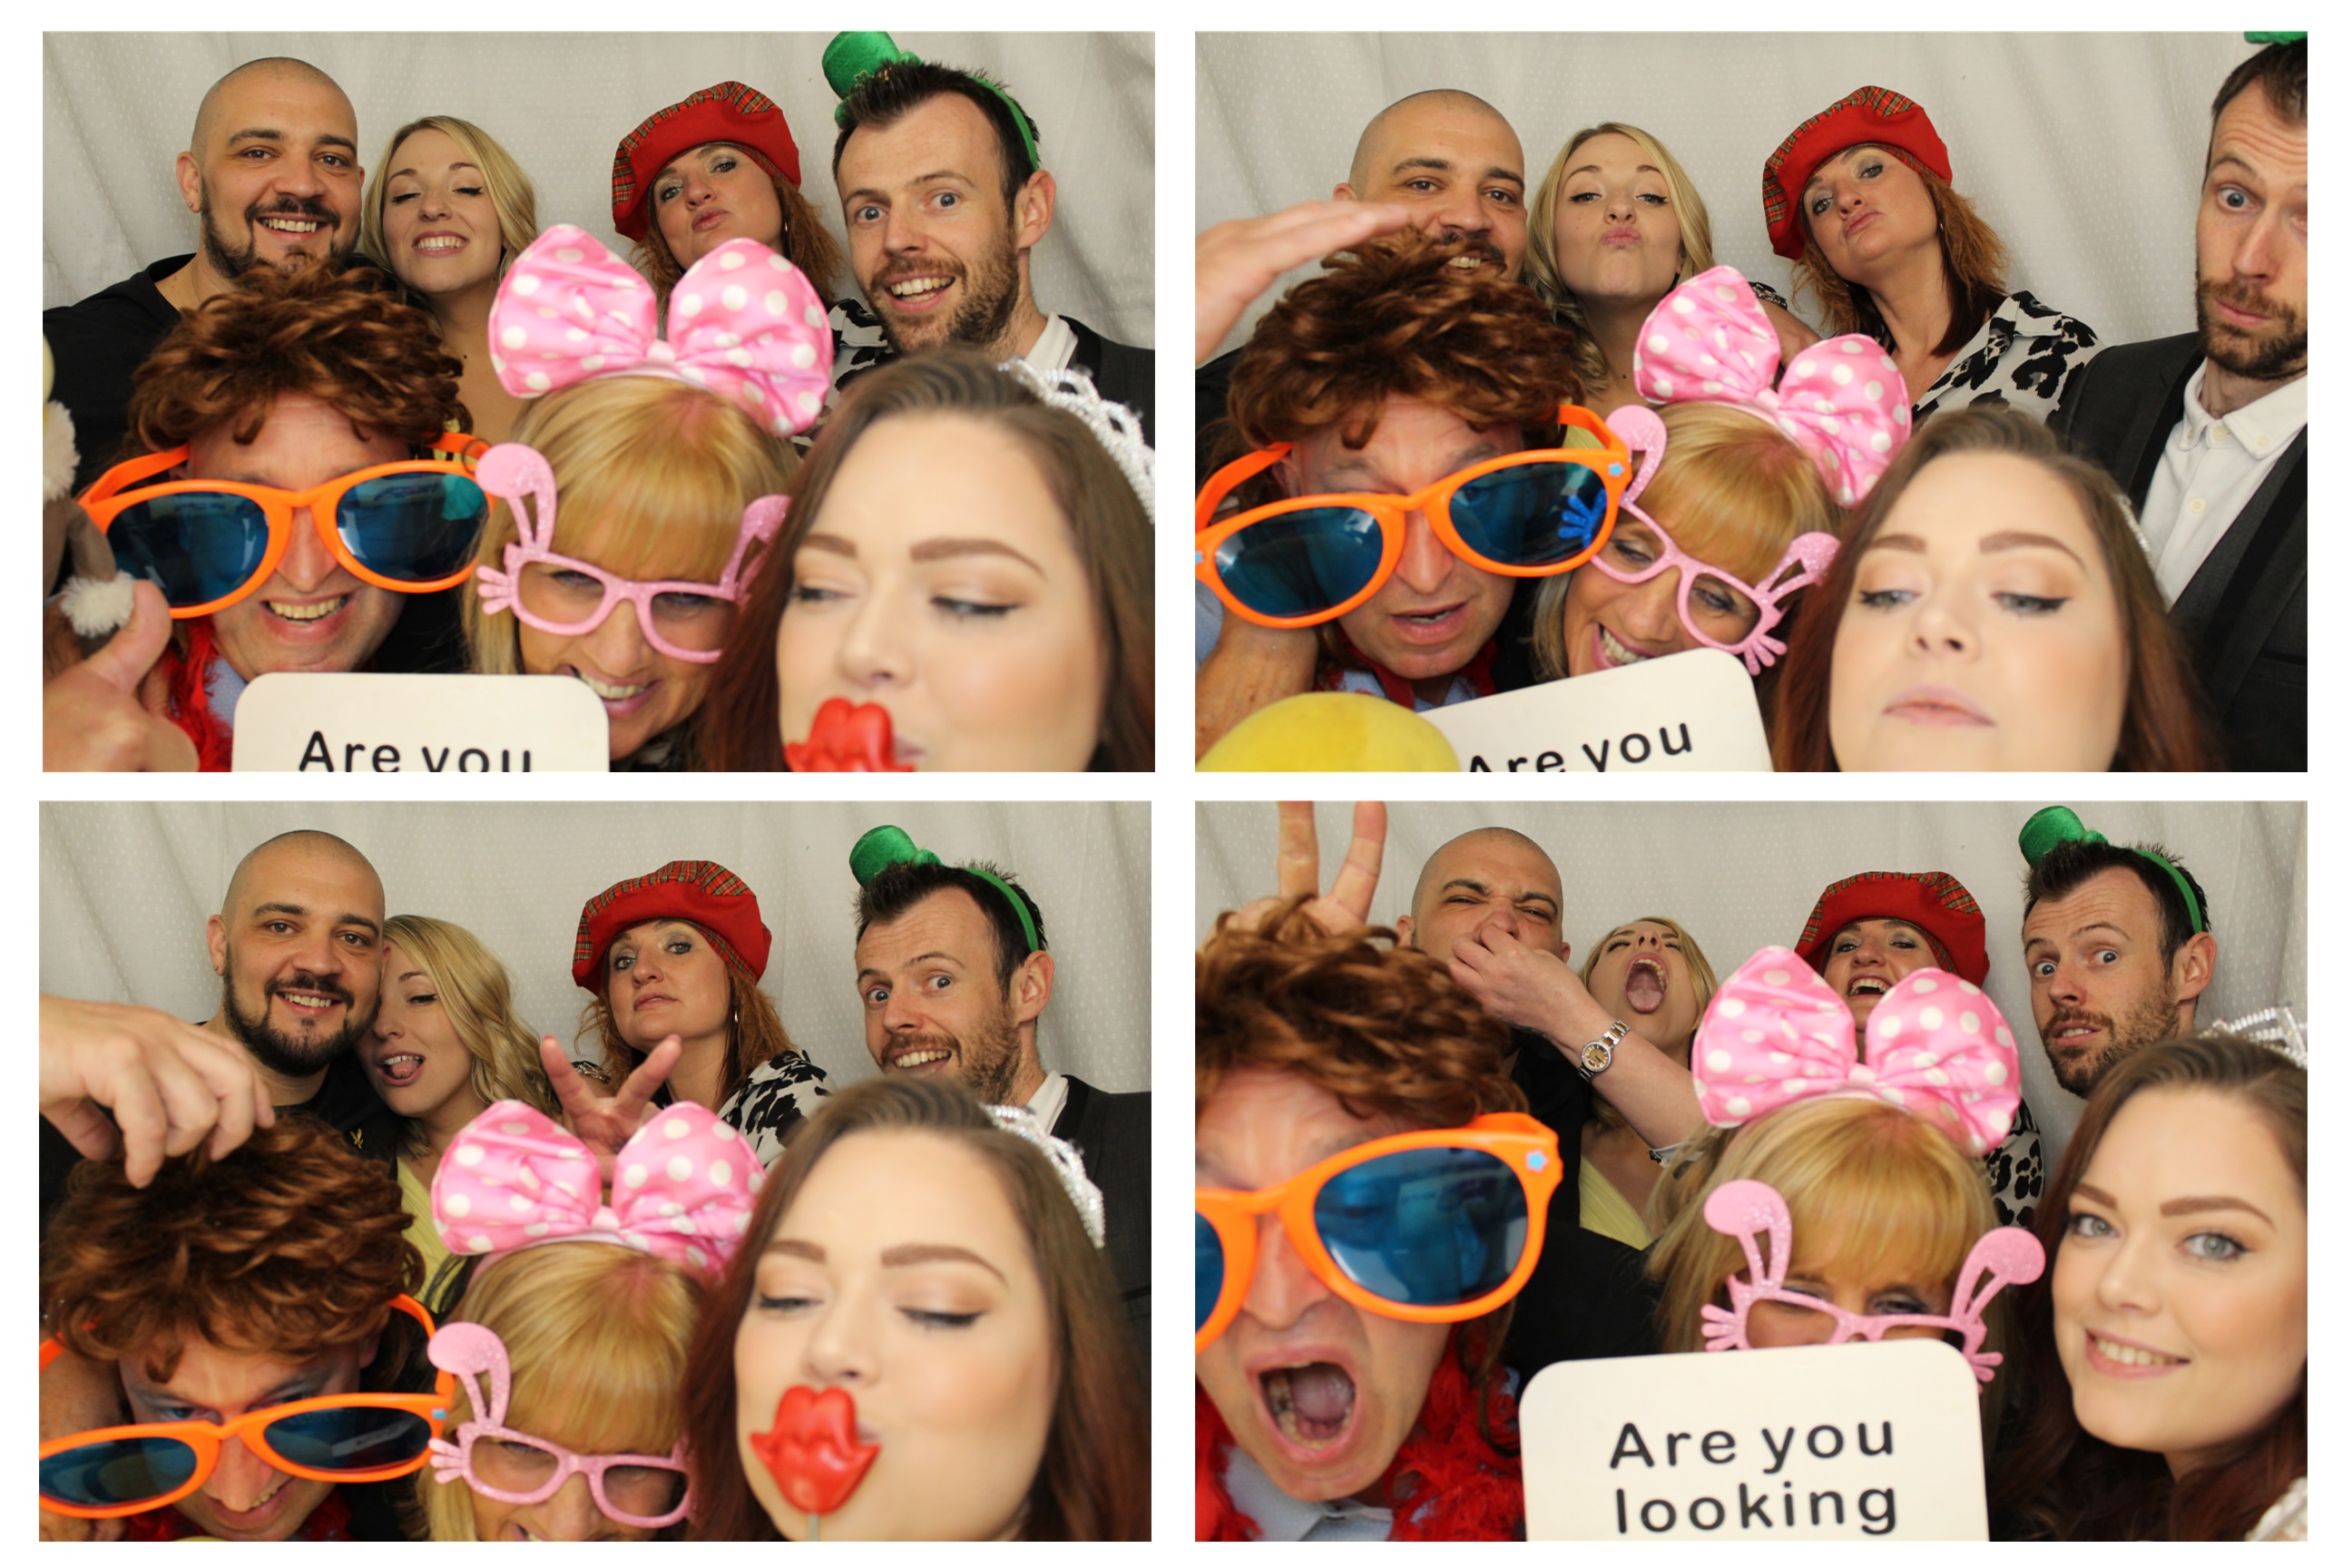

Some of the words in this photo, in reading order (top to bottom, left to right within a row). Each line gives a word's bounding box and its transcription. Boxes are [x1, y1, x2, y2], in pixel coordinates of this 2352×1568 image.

[299, 730, 400, 771] Are
[1582, 722, 1692, 771] you
[1610, 1422, 1736, 1469] Are
[1761, 1421, 1893, 1475] you
[1616, 1481, 1896, 1535] looking
